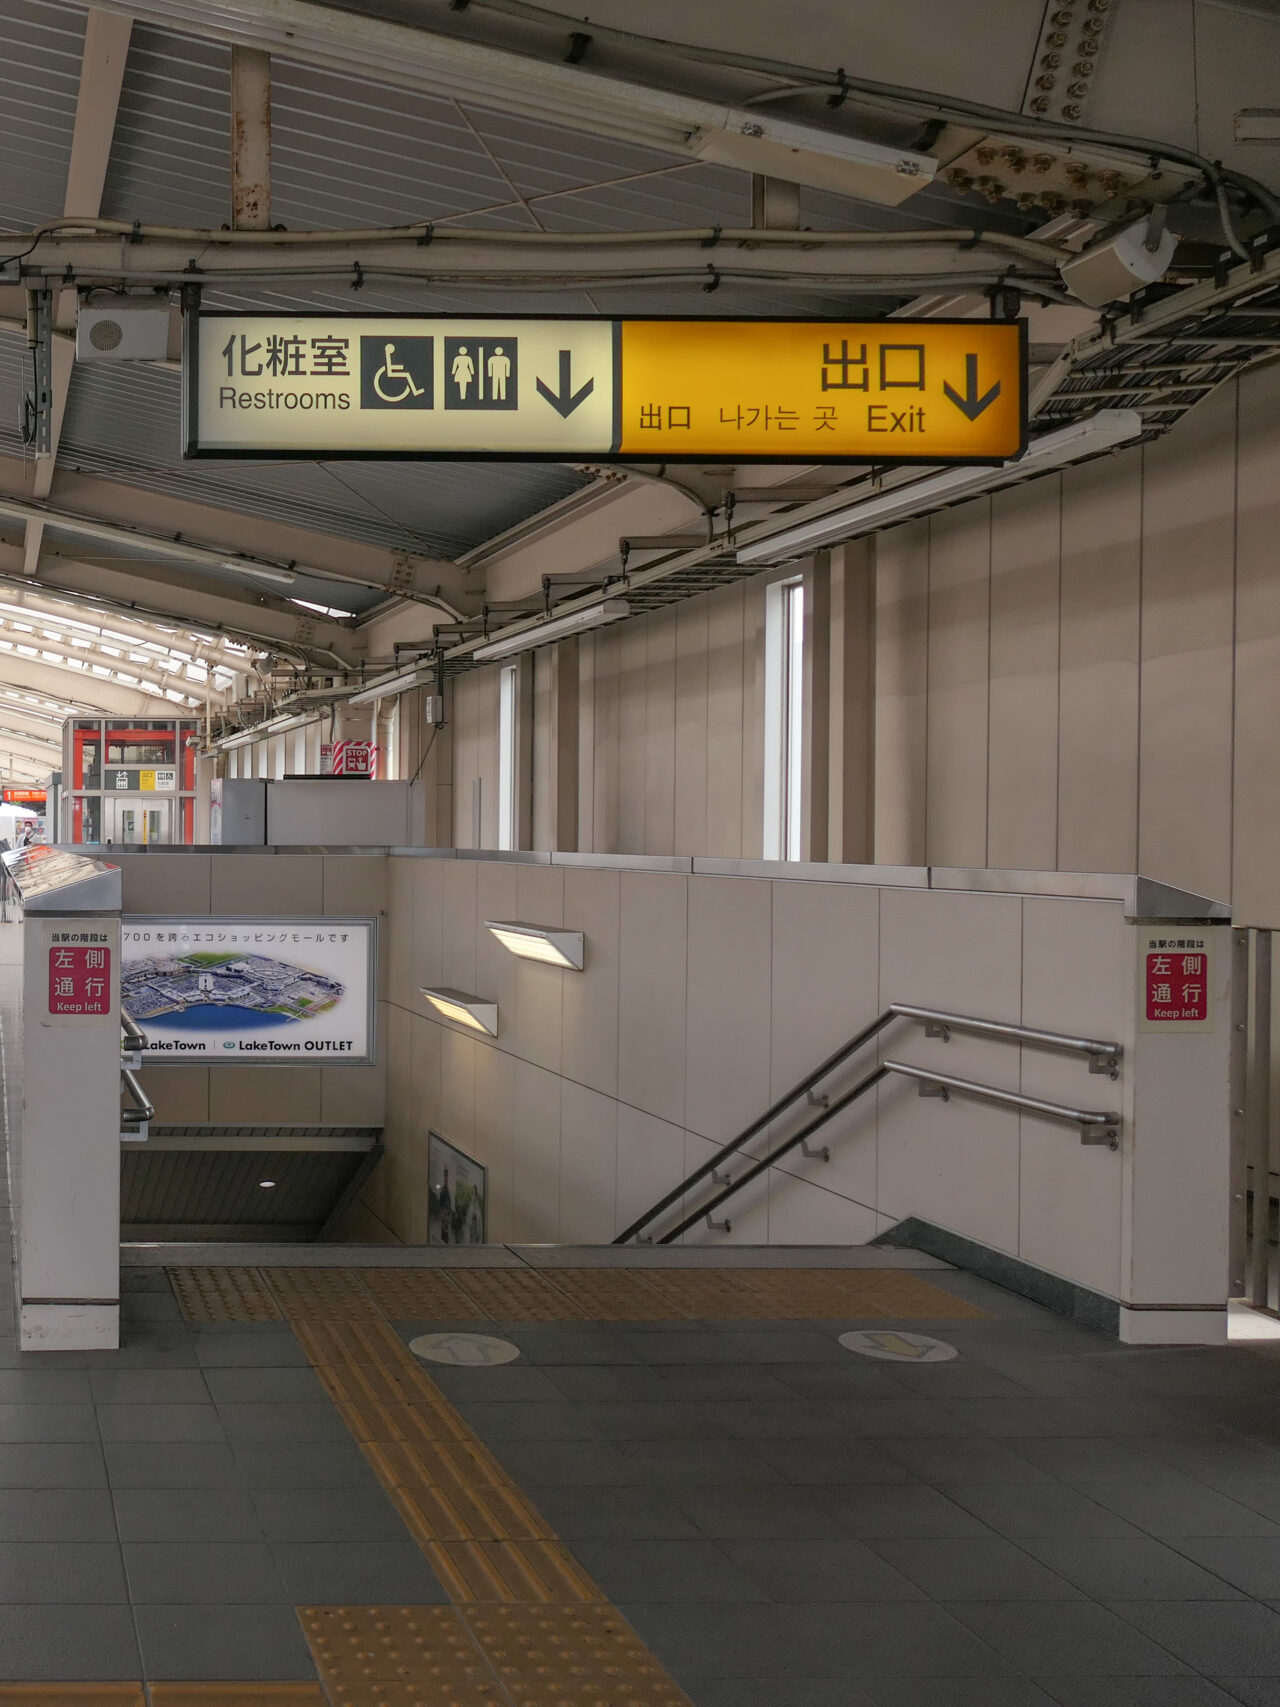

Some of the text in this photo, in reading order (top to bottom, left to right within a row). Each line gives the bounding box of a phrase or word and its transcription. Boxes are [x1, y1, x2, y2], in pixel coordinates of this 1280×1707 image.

[221, 334, 351, 378] 化粧室
[821, 340, 926, 392] 出口
[219, 387, 351, 410] Restrooms
[639, 403, 690, 430] 出口
[719, 405, 838, 431] 나가는 곳
[867, 405, 926, 433] Exit
[7, 791, 12, 800] 1
[52, 933, 108, 942] 当駅の階段は
[55, 949, 105, 969] 左側
[1152, 956, 1202, 975] 左側
[54, 977, 105, 997] 通行
[1152, 983, 1202, 1003] 通行
[57, 1002, 102, 1013] Keep left
[1154, 1008, 1199, 1019] Keep left
[239, 1040, 300, 1050] LakeTown
[304, 1040, 353, 1050] OUTLET
